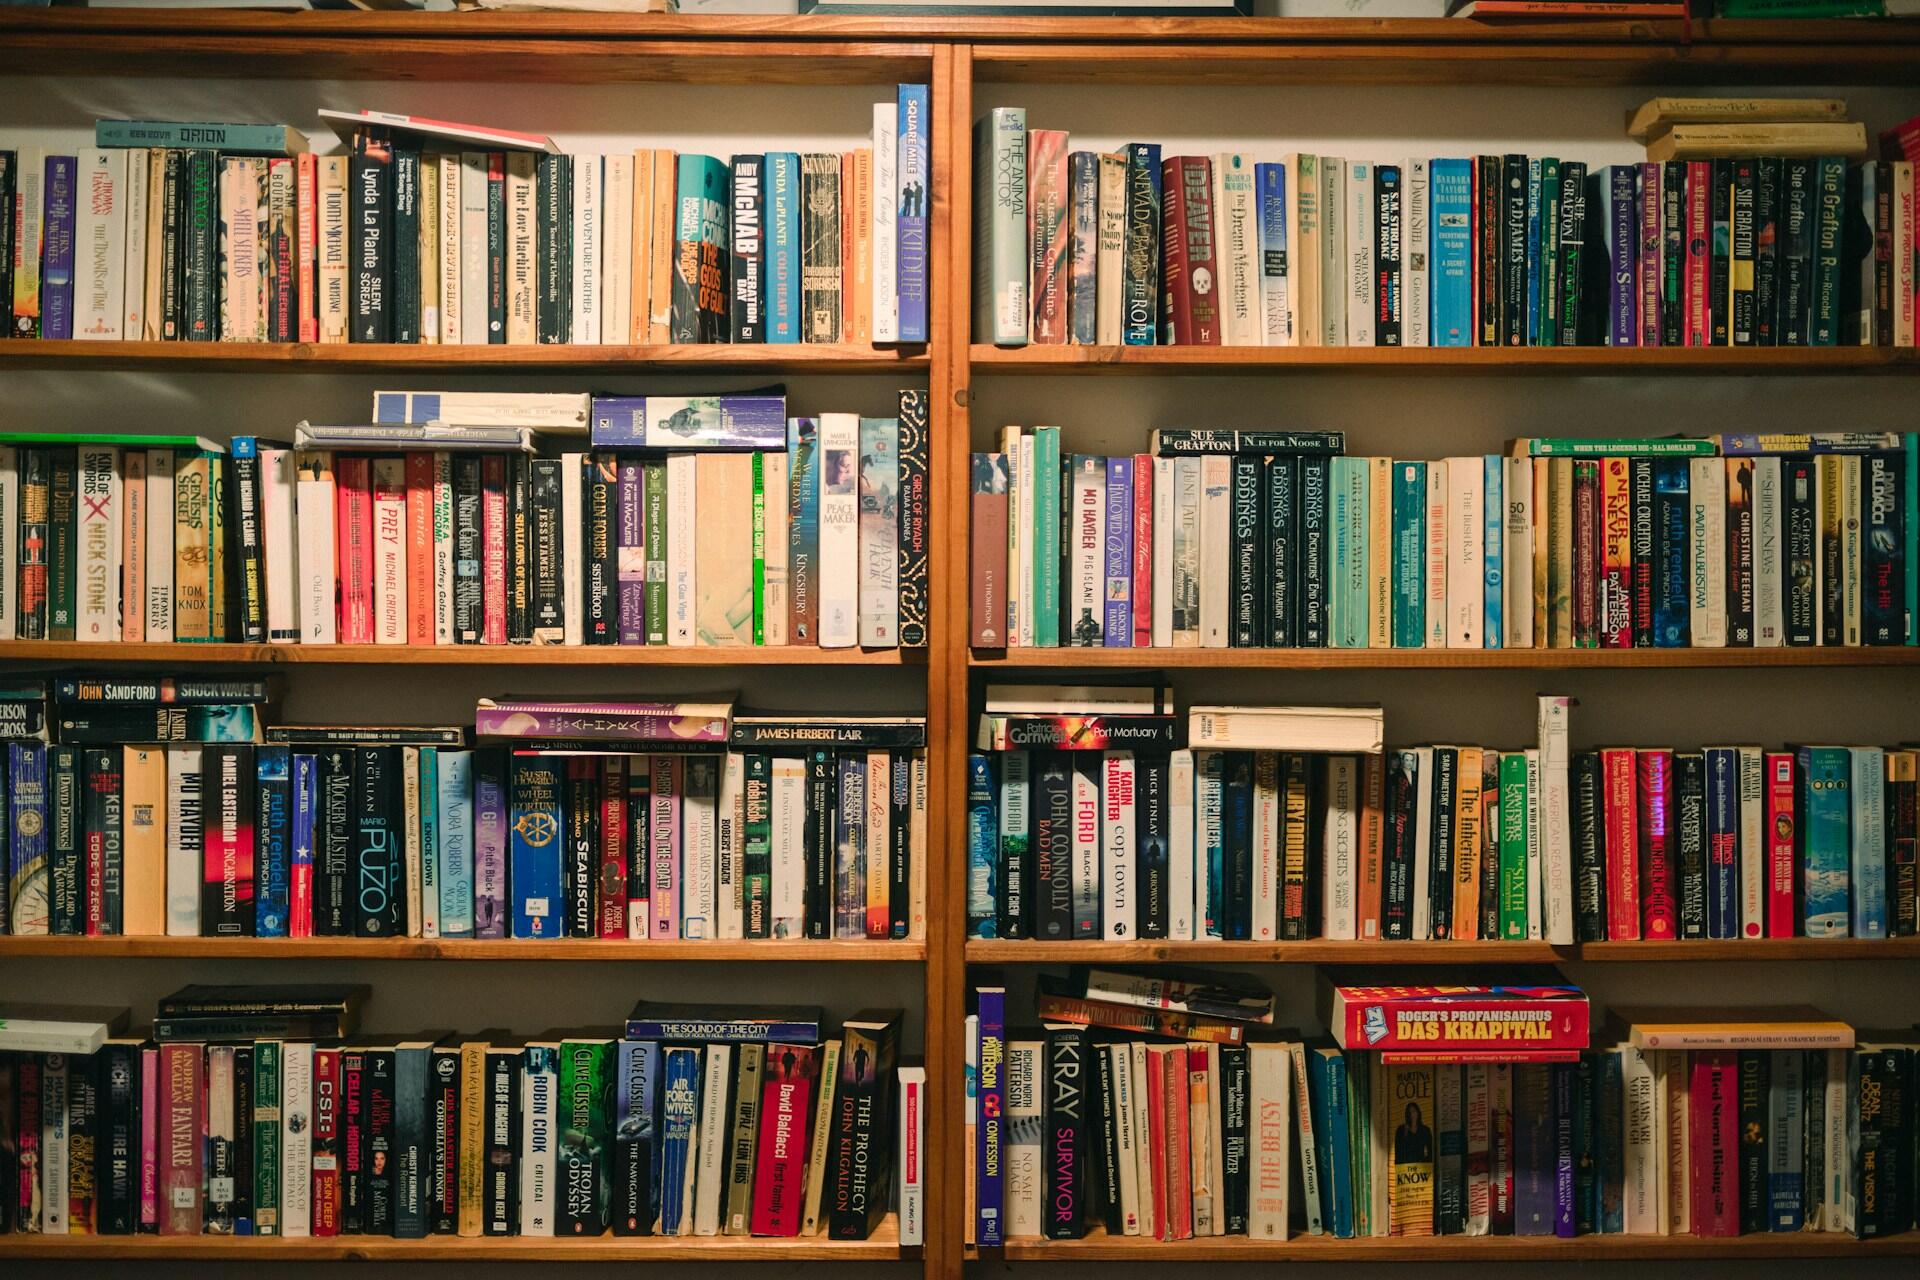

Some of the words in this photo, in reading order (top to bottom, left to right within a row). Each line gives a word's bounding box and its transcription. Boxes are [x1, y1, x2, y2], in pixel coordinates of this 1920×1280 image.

[907, 99, 918, 144] SQUARE
[907, 145, 918, 174] MILE
[1010, 134, 1024, 163] THE
[360, 168, 381, 205] Lynda
[736, 163, 758, 177] ANDY
[776, 159, 787, 193] LYNDA
[997, 148, 1011, 207] DOCTOR
[1048, 163, 1059, 187] The
[1824, 164, 1842, 191] Sue
[516, 184, 531, 205] The
[1010, 167, 1024, 219] ANIMAL
[1133, 168, 1151, 230] NEVADA
[1736, 188, 1753, 207] SUE
[364, 210, 379, 225] La
[517, 207, 531, 233] Love
[582, 208, 593, 220] TO
[735, 177, 759, 253] McNAB
[1047, 190, 1059, 244] Russian
[1735, 209, 1753, 256] GRAFTON
[1821, 195, 1841, 249] Grafton
[364, 228, 380, 269] Plante
[516, 235, 531, 284] Machine
[582, 222, 594, 265] VENTURE
[1133, 235, 1150, 276] BARR
[777, 250, 788, 280] COLD
[1046, 247, 1058, 316] Concubine
[360, 272, 371, 315] SCREAM
[371, 277, 381, 311] SILENT
[582, 269, 594, 314] FURTHER
[737, 279, 747, 302] DAY
[747, 257, 757, 323] LIBERATION
[777, 283, 788, 317] HEART
[1135, 279, 1146, 297] THE
[1130, 299, 1148, 340] ROPE
[1174, 440, 1232, 451] GRAFTON
[1190, 430, 1214, 441] SUE
[1244, 436, 1254, 447] N
[1287, 436, 1320, 447] NOOSE
[84, 453, 97, 495] SWORDS
[97, 453, 112, 481] KING
[98, 483, 109, 495] OF
[593, 484, 607, 517] COLIN
[903, 485, 911, 508] RAJAA
[912, 474, 923, 501] GIRLS
[1083, 489, 1097, 506] MO
[1237, 463, 1255, 539] EDDINGS
[1871, 459, 1884, 525] BALDACCI
[381, 508, 398, 545] PREY
[903, 510, 912, 541] ALSANEA
[912, 503, 922, 515] OF
[88, 523, 106, 560] NICK
[593, 519, 607, 559] FORBES
[912, 517, 923, 553] RIYADH
[1082, 509, 1097, 550] HAYDER
[385, 551, 396, 591] MICHAEL
[1240, 543, 1254, 591] MAGICIAN'S
[87, 565, 106, 616] STONE
[151, 587, 160, 629] HARRIS
[160, 586, 169, 630] THOMAS
[591, 563, 602, 618] SISTERHOOD
[1240, 593, 1253, 625] GAMBIT
[1609, 571, 1620, 644] PATTERSON
[1619, 587, 1630, 628] JAMES
[385, 594, 397, 638] CRICHTON
[78, 683, 103, 701] JOHN
[105, 683, 157, 701] SANDFORD
[180, 682, 219, 698] SHOCK
[221, 682, 250, 698] WAVE
[756, 728, 791, 740] JAMES
[791, 728, 836, 740] HERBERT
[838, 728, 863, 740] LAIR
[1093, 727, 1113, 738] Port
[1114, 727, 1158, 741] Mortuary
[223, 755, 237, 786] DANIEL
[366, 751, 379, 812] SICILIAN
[1440, 754, 1450, 771] SARA
[1107, 757, 1120, 821] SLAUGHTER
[1120, 771, 1133, 806] KARIN
[1440, 773, 1450, 807] PARETSKY
[1460, 786, 1480, 815] The
[106, 794, 119, 825] KEN
[223, 788, 237, 842] EASTERMAN
[360, 817, 387, 826] MARIO
[657, 800, 671, 825] STILL
[1047, 788, 1069, 828] JOHN
[1078, 801, 1095, 843] FORD
[1440, 814, 1449, 838] BITTER
[1682, 795, 1692, 853] SANDERS
[1690, 795, 1702, 852] Lawrence
[91, 835, 100, 868] CODE
[656, 827, 669, 840] ON
[656, 843, 669, 859] THE
[1040, 819, 1051, 848] BAD
[1110, 825, 1128, 858] cop
[1459, 817, 1479, 884] Inheritors
[105, 830, 119, 896] FOLLETT
[360, 828, 387, 913] PUZO
[1040, 851, 1051, 881] MEN
[1051, 833, 1069, 912] CONNOLLY
[1439, 839, 1449, 872] MEDICINE
[91, 871, 100, 887] TO
[224, 848, 236, 912] INCARNATION
[577, 840, 589, 932] SEABISCUIT
[1114, 864, 1128, 909] town
[1683, 876, 1693, 920] DILEMMA
[1692, 872, 1702, 922] McNALLY'S
[91, 890, 100, 921] ZERO
[1397, 1010, 1448, 1022] ROGER'S
[1451, 1010, 1553, 1022] PROFANISAURUS
[1397, 1021, 1440, 1040] DAS
[1444, 1021, 1553, 1040] KRAPITAL
[171, 1050, 183, 1104] MACALLAN
[182, 1050, 194, 1103] ANDREW
[574, 1050, 593, 1081] CLIVE
[630, 1047, 648, 1074] CLIVE
[981, 1036, 997, 1089] PATTERSON
[1010, 1049, 1023, 1108] PATTERSON
[1023, 1049, 1033, 1082] RICHARD
[532, 1076, 548, 1114] ROBIN
[629, 1076, 646, 1117] CUSSLER
[777, 1084, 795, 1113] David
[1022, 1083, 1033, 1108] NORTH
[1053, 1040, 1081, 1120] KRAY
[1861, 1074, 1872, 1122] KOONTZ
[1871, 1082, 1881, 1114] DEAN
[319, 1080, 334, 1132] CSI:
[573, 1082, 592, 1128] CUSSLER
[840, 1096, 855, 1133] JOHN
[856, 1095, 872, 1127] THE
[171, 1107, 194, 1168] FANFARE
[532, 1119, 547, 1153] COOK
[629, 1142, 638, 1160] THE
[774, 1115, 794, 1159] Baldacci
[985, 1120, 998, 1177] CONFESSION
[836, 1137, 852, 1212] KILGALLON
[851, 1133, 871, 1215] PROPHECY
[1056, 1127, 1075, 1222] SURVIVOR
[1865, 1151, 1875, 1169] THE
[534, 1164, 543, 1203] CRITICAL
[568, 1158, 580, 1218] ODYSSEY
[580, 1162, 593, 1214] TROJAN
[628, 1161, 638, 1215] NAVIGATOR
[1864, 1174, 1875, 1213] VISION
